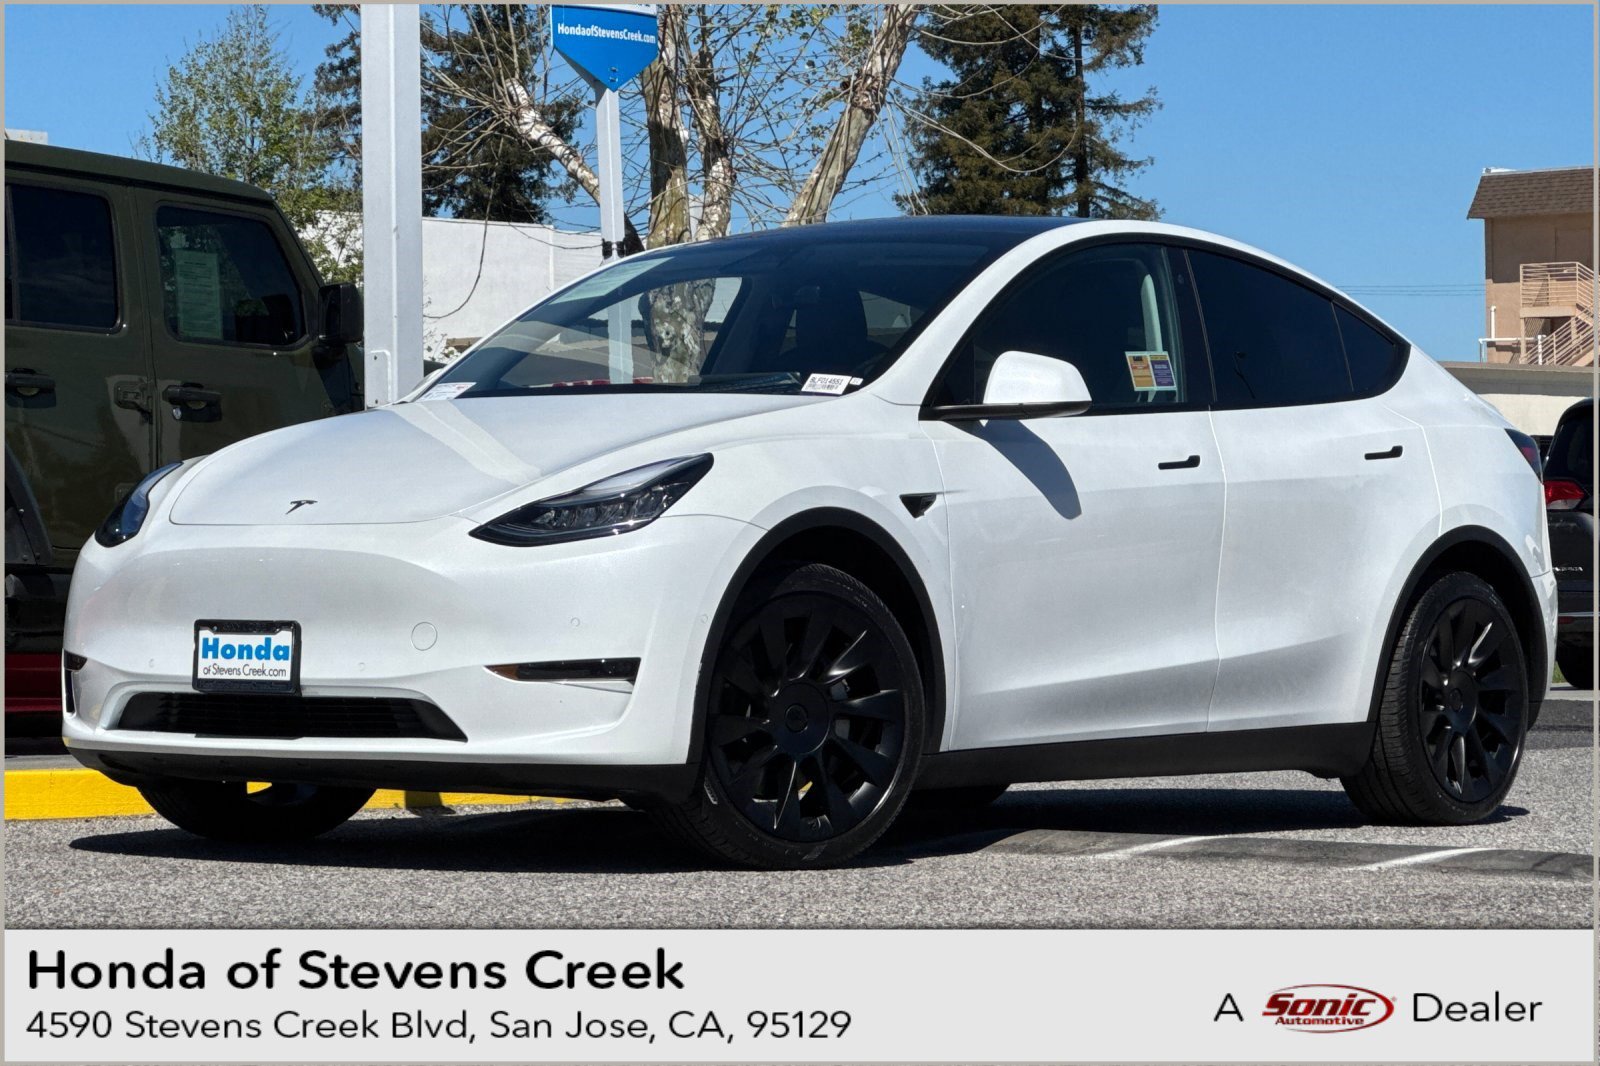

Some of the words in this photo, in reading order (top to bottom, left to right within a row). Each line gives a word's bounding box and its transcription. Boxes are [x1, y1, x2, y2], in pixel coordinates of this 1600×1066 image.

[557, 23, 656, 44] HondaofStevensCreek.com
[202, 637, 290, 661] Honda
[203, 665, 212, 675] of
[212, 663, 241, 676] Stevens
[242, 663, 287, 677] Creek.com
